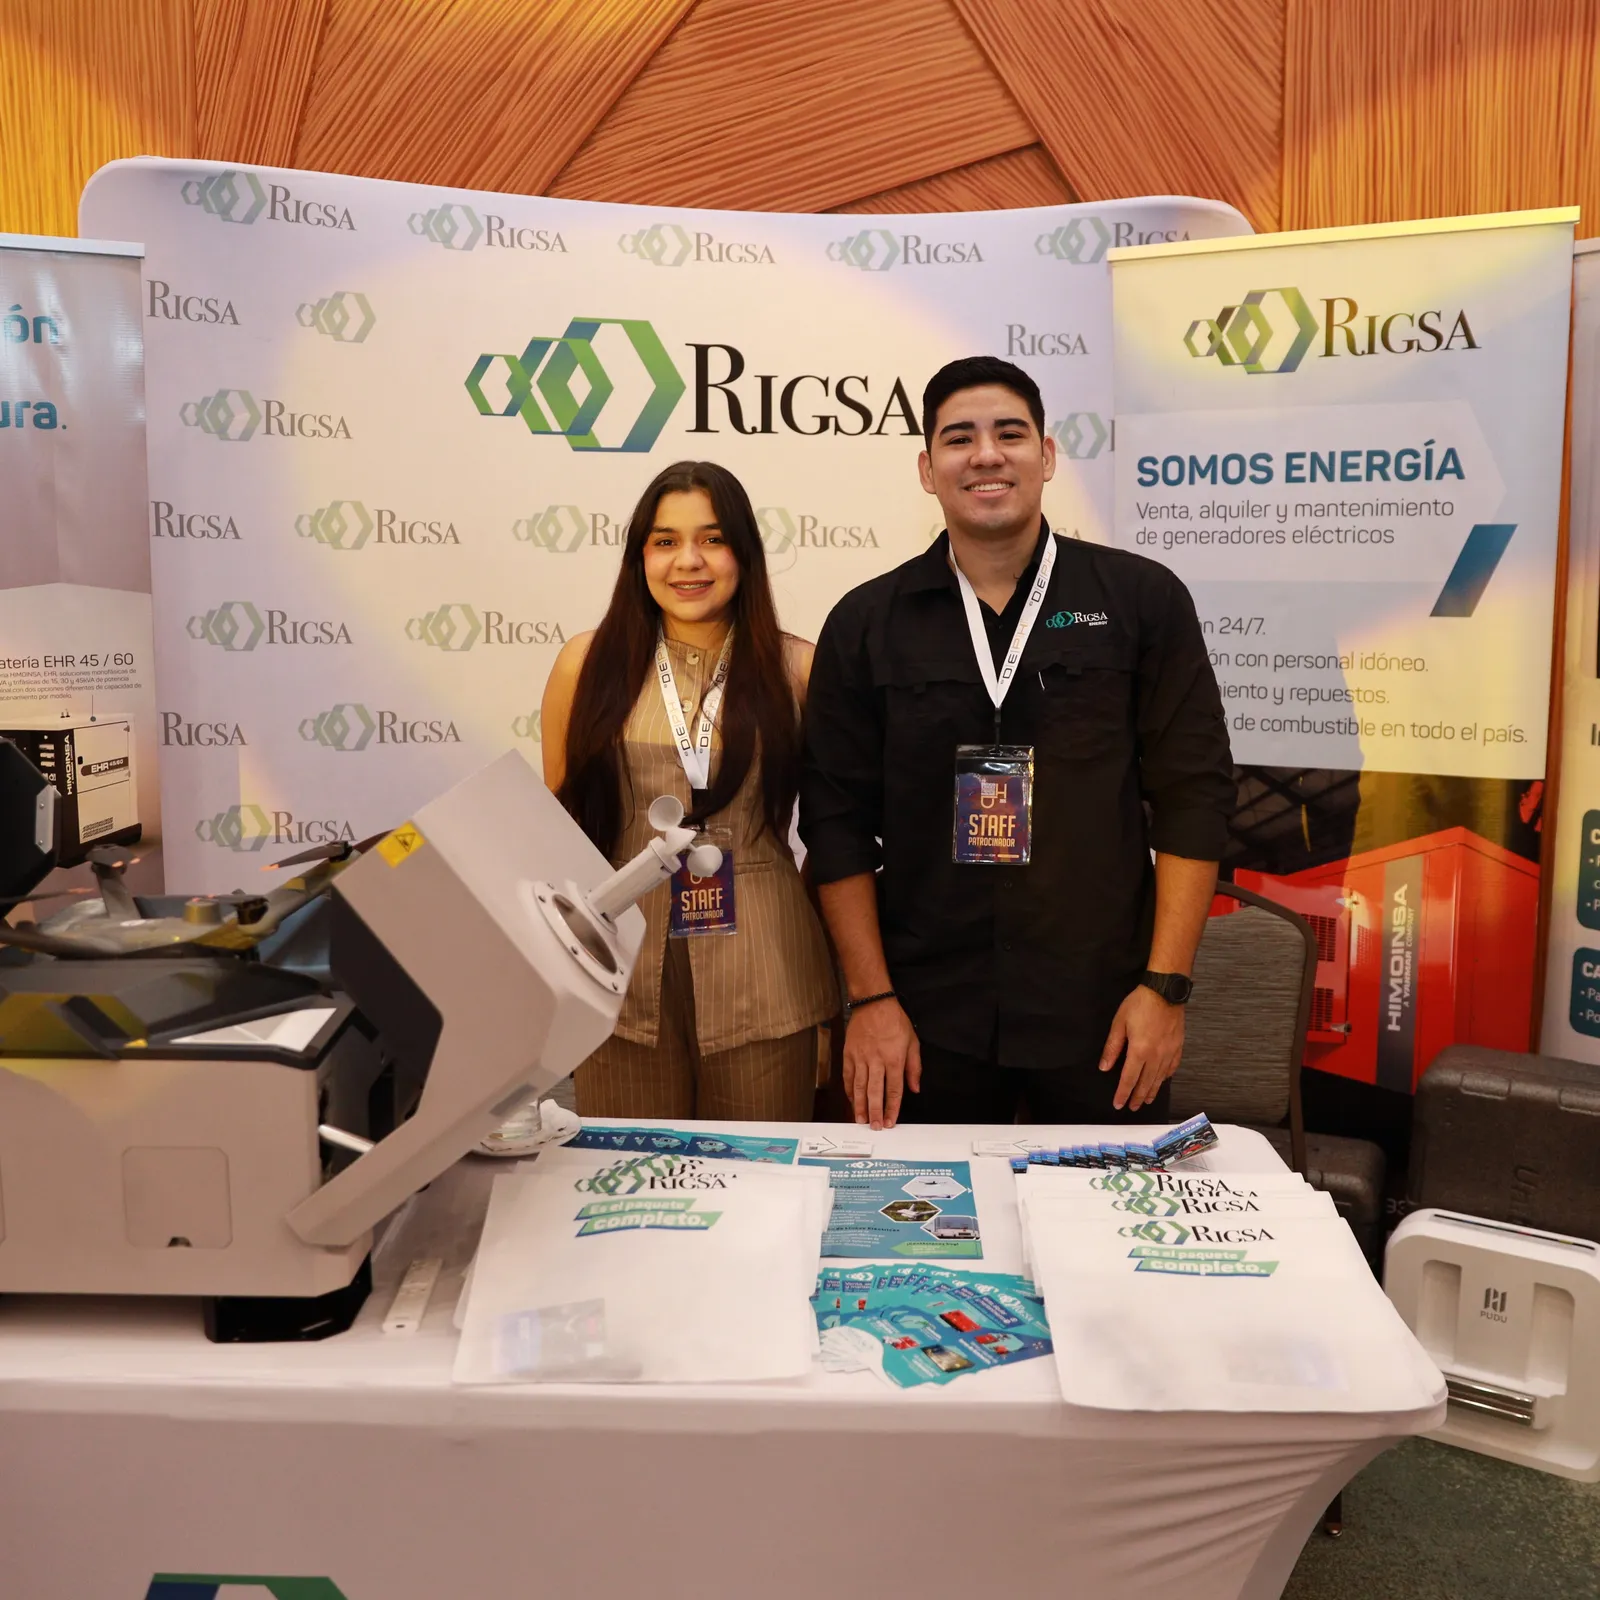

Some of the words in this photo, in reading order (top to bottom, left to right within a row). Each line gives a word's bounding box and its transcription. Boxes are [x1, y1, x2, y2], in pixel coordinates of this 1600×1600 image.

[267, 184, 357, 231] RIGSA
[485, 214, 568, 253] RIGSA
[692, 231, 776, 265] RIGSA
[901, 234, 984, 264] RIGSA
[146, 280, 240, 325] RIGSA
[1005, 324, 1090, 356] RIGSA
[1318, 297, 1481, 357] RIGSA
[685, 343, 924, 437] RIGSA
[261, 400, 353, 440] RIGSA
[1136, 452, 1273, 487] SOMOS
[1285, 439, 1465, 484] ENERGÍA
[151, 501, 242, 540] RIGSA
[1136, 501, 1193, 522] Venta,
[1199, 499, 1271, 523] alquiler
[1276, 504, 1288, 523] y
[1294, 498, 1454, 518] mantenimiento
[374, 509, 461, 545] RIGSA
[797, 515, 880, 548] RIGSA
[1136, 526, 1157, 546] de
[1163, 525, 1286, 550] generadores
[1292, 524, 1394, 546] eléctricos
[265, 610, 353, 644] RIGSA
[482, 611, 566, 644] RIGSA
[1072, 611, 1109, 624] RIGSA
[1219, 616, 1266, 636] 24/7.
[44, 655, 76, 667] EHR
[79, 654, 99, 667] 45
[113, 652, 134, 666] 60
[1235, 653, 1268, 668] con
[1273, 650, 1354, 672] personal
[1360, 650, 1429, 673] idóneo.
[1273, 687, 1284, 705] y
[1289, 685, 1390, 706] repuestos.
[161, 712, 247, 746] RIGSA
[376, 710, 461, 743] RIGSA
[1233, 712, 1256, 731] de
[1260, 714, 1375, 737] combustible
[1381, 722, 1405, 738] en
[1410, 720, 1455, 741] todo
[1461, 721, 1477, 741] el
[1483, 724, 1528, 746] país.
[91, 762, 109, 774] EHR
[271, 811, 356, 844] RIGSA
[968, 814, 1017, 837] STAFF
[968, 836, 1016, 848] PATROCINADOR
[681, 888, 723, 912] STAFF
[681, 909, 724, 922] PATROCINADOR
[1387, 883, 1408, 1032] HIMOINSA
[649, 1176, 728, 1190] RIGSA
[1156, 1173, 1231, 1192] RIGSA
[593, 1210, 708, 1229] completo.
[1181, 1198, 1261, 1214] RIGSA
[1190, 1225, 1275, 1243] RIGSA
[1150, 1260, 1267, 1275] completo.
[1480, 1310, 1508, 1323] PUDU
